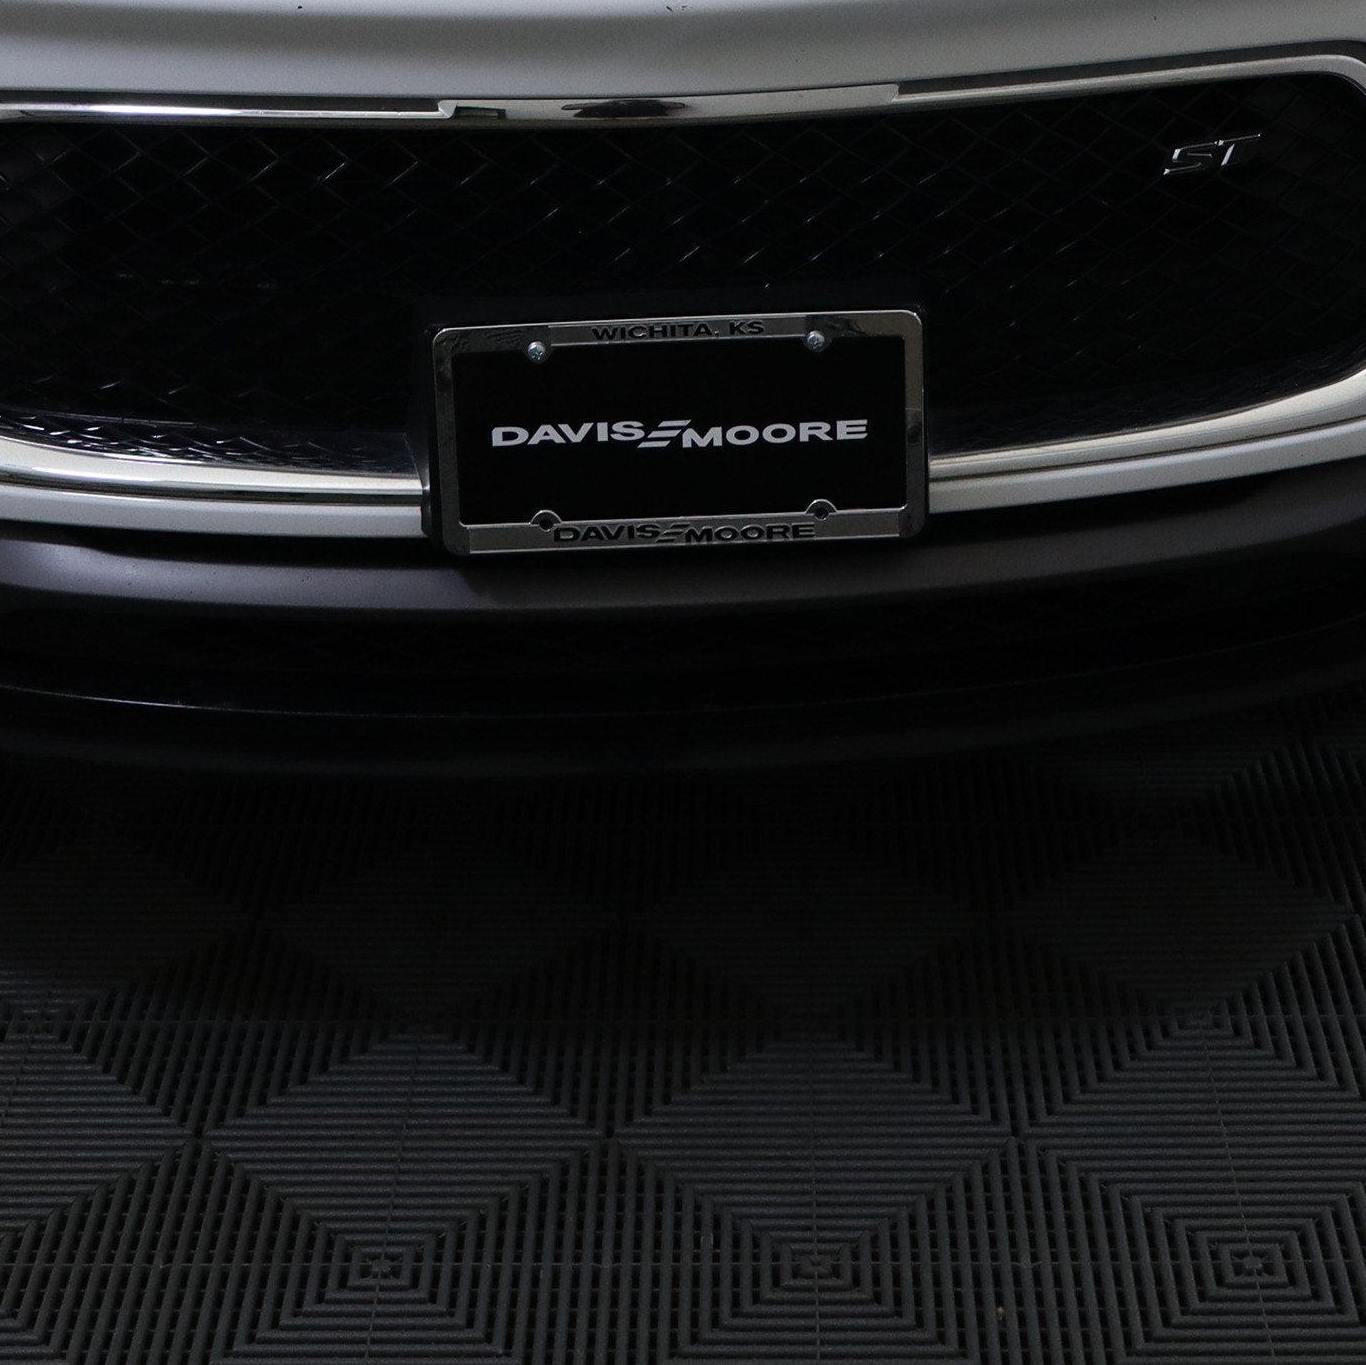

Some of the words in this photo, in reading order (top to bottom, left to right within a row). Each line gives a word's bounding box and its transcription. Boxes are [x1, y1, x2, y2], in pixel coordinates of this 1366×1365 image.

[1162, 132, 1263, 176] ST
[729, 320, 766, 336] KS
[491, 420, 645, 448] DAVIS
[681, 418, 869, 449] MOORE
[553, 523, 661, 543] DAVIS
[684, 522, 816, 544] MOORE
